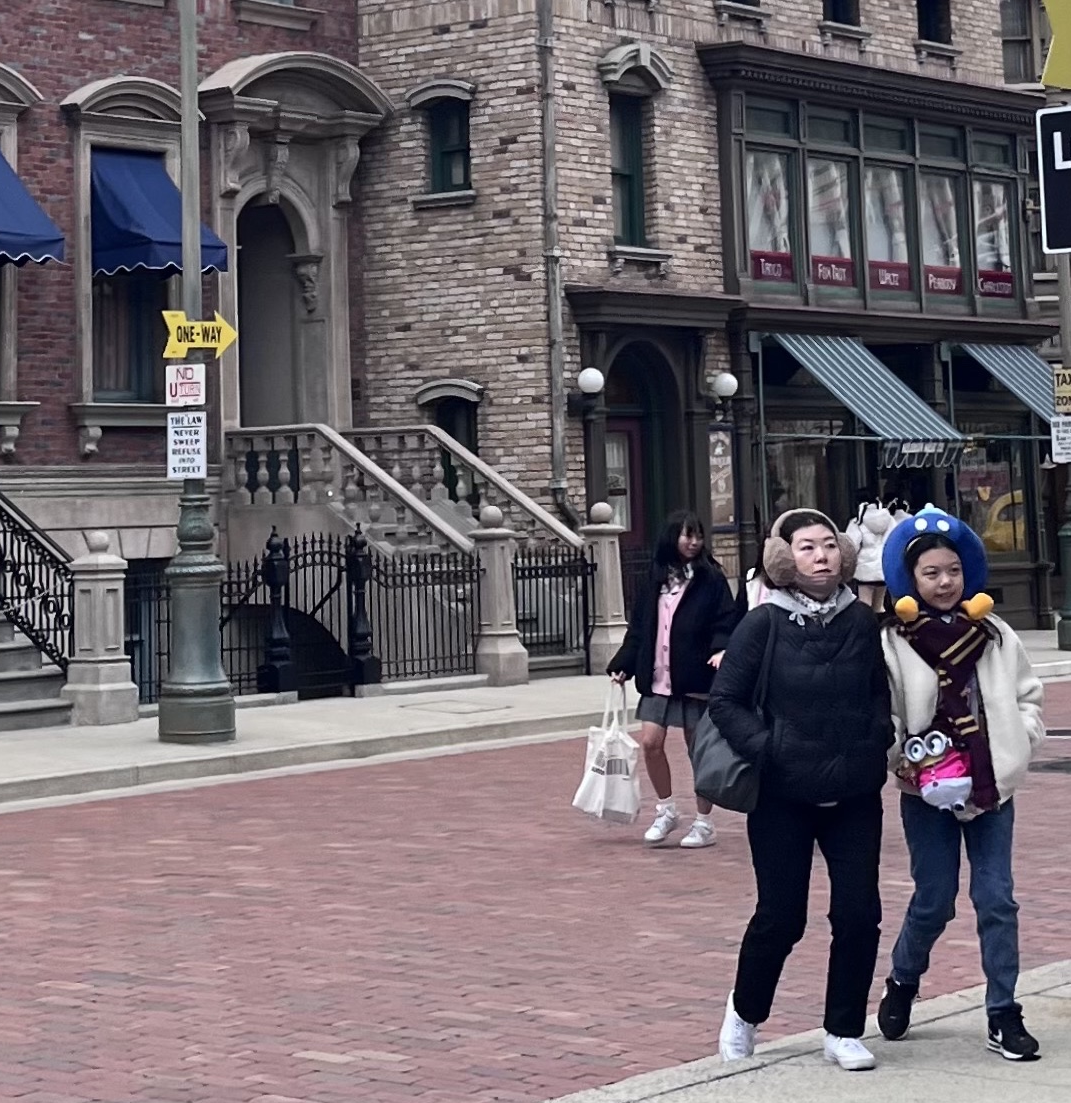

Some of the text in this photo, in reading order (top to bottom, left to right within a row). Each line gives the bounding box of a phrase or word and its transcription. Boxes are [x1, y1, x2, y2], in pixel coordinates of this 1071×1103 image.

[176, 324, 222, 343] ONE-WAY
[176, 367, 194, 380] NO
[170, 382, 200, 397] U TURN
[171, 416, 202, 426] THE LAW
